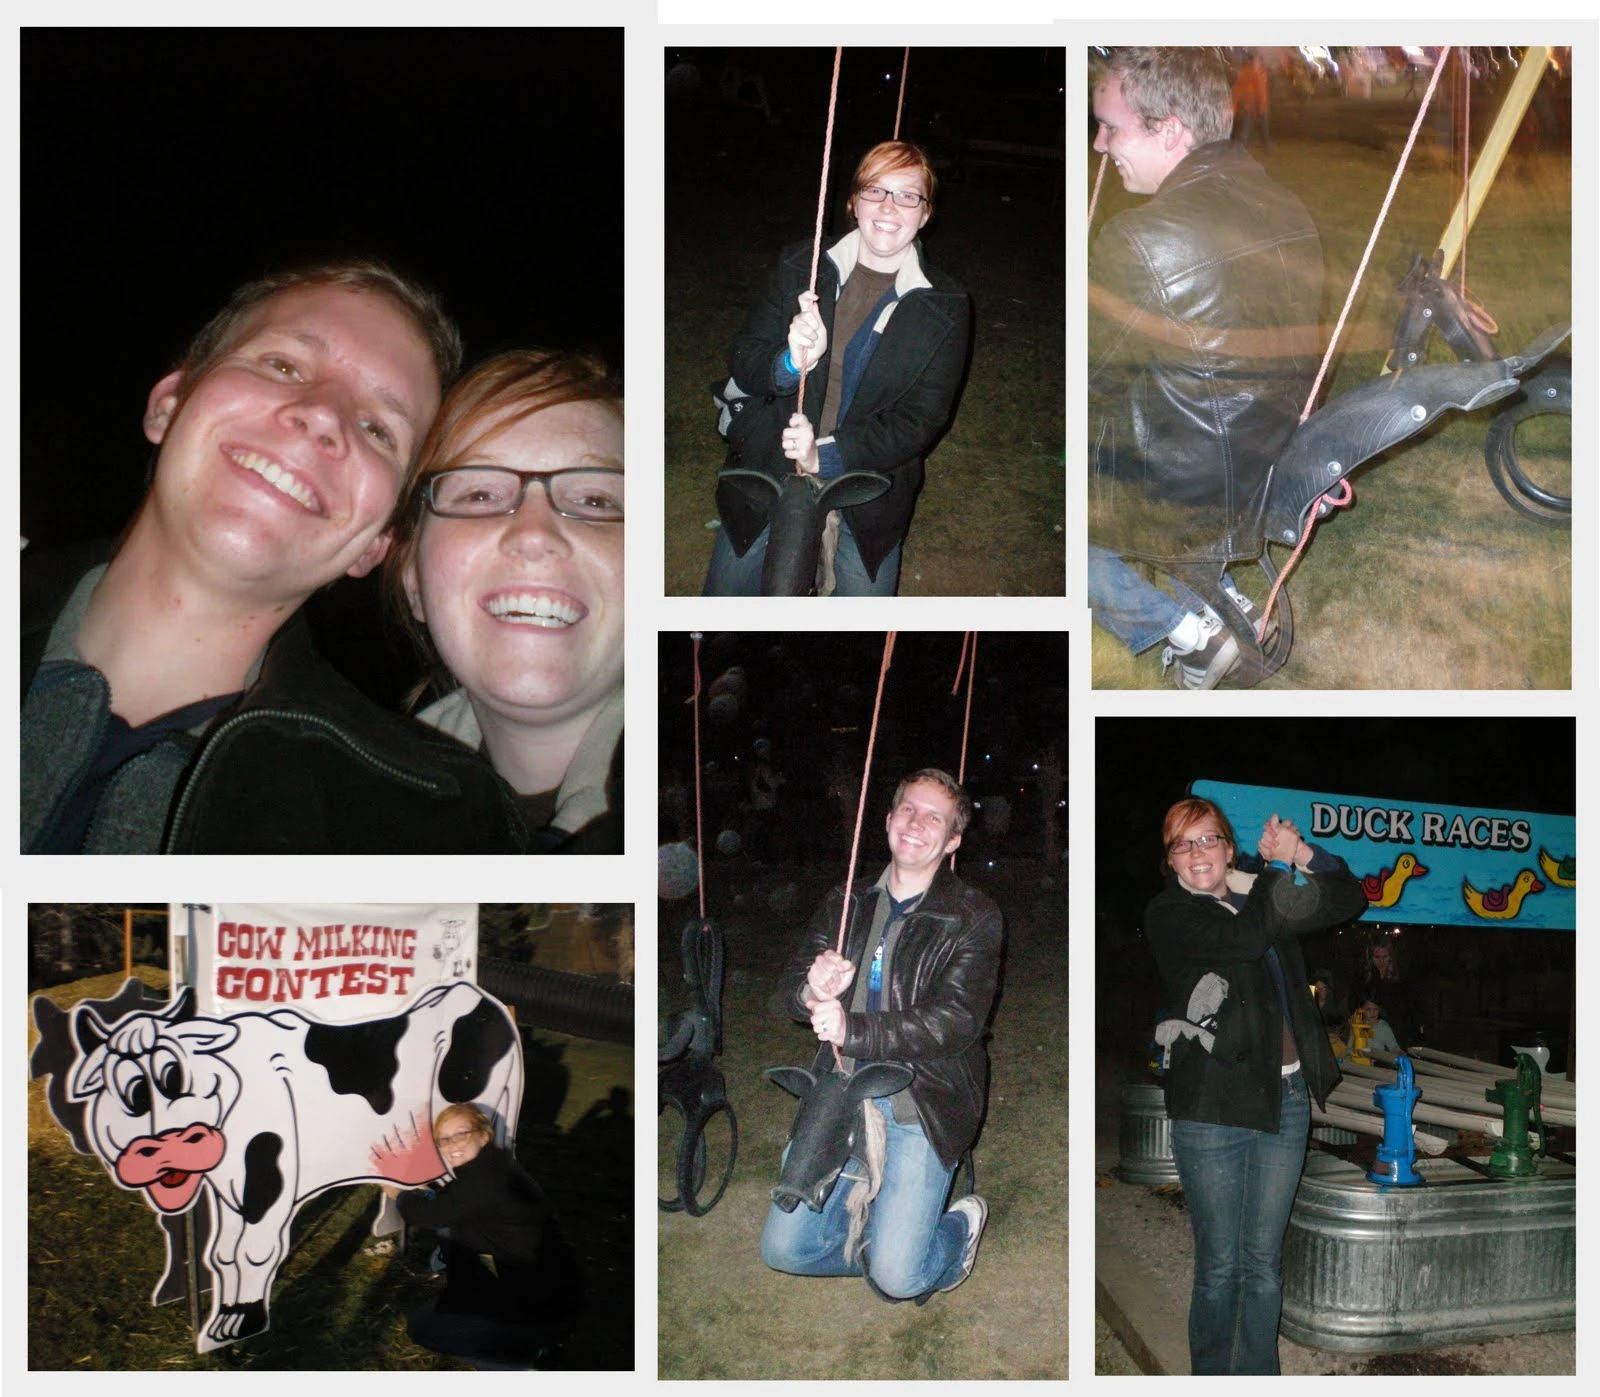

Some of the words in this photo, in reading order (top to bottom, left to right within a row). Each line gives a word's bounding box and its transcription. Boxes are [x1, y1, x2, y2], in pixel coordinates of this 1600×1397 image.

[1311, 802, 1414, 842] DUCK
[1422, 812, 1531, 851] RACES
[218, 922, 286, 960] COW
[293, 924, 417, 960] MILKING
[217, 963, 414, 1002] CONTEST
